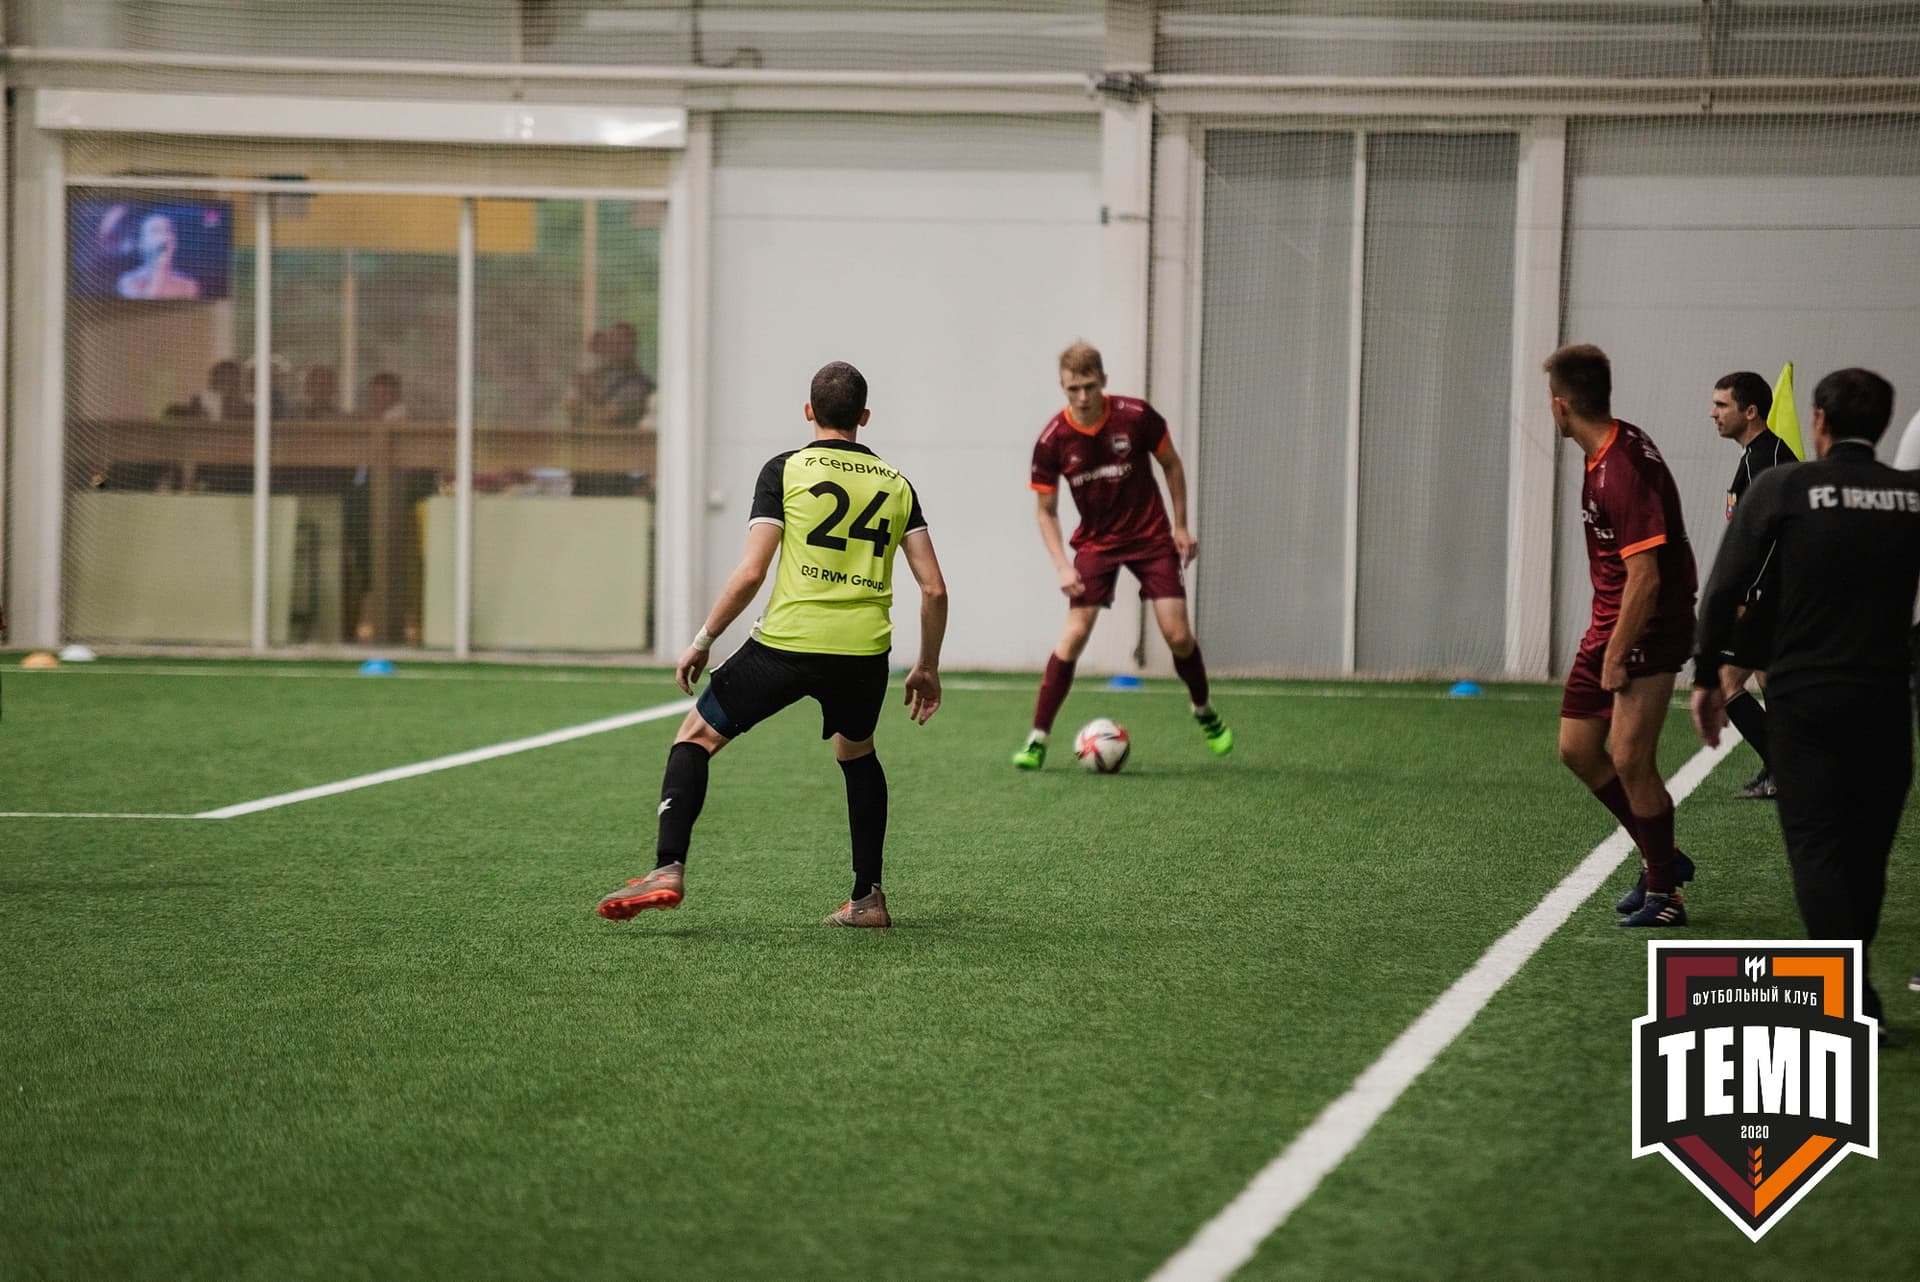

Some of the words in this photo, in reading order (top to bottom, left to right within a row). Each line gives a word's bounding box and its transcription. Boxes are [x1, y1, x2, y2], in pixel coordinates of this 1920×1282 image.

[1808, 486, 1839, 510] FC
[806, 481, 891, 558] 24
[821, 569, 847, 585] RVM
[851, 574, 885, 592] Group
